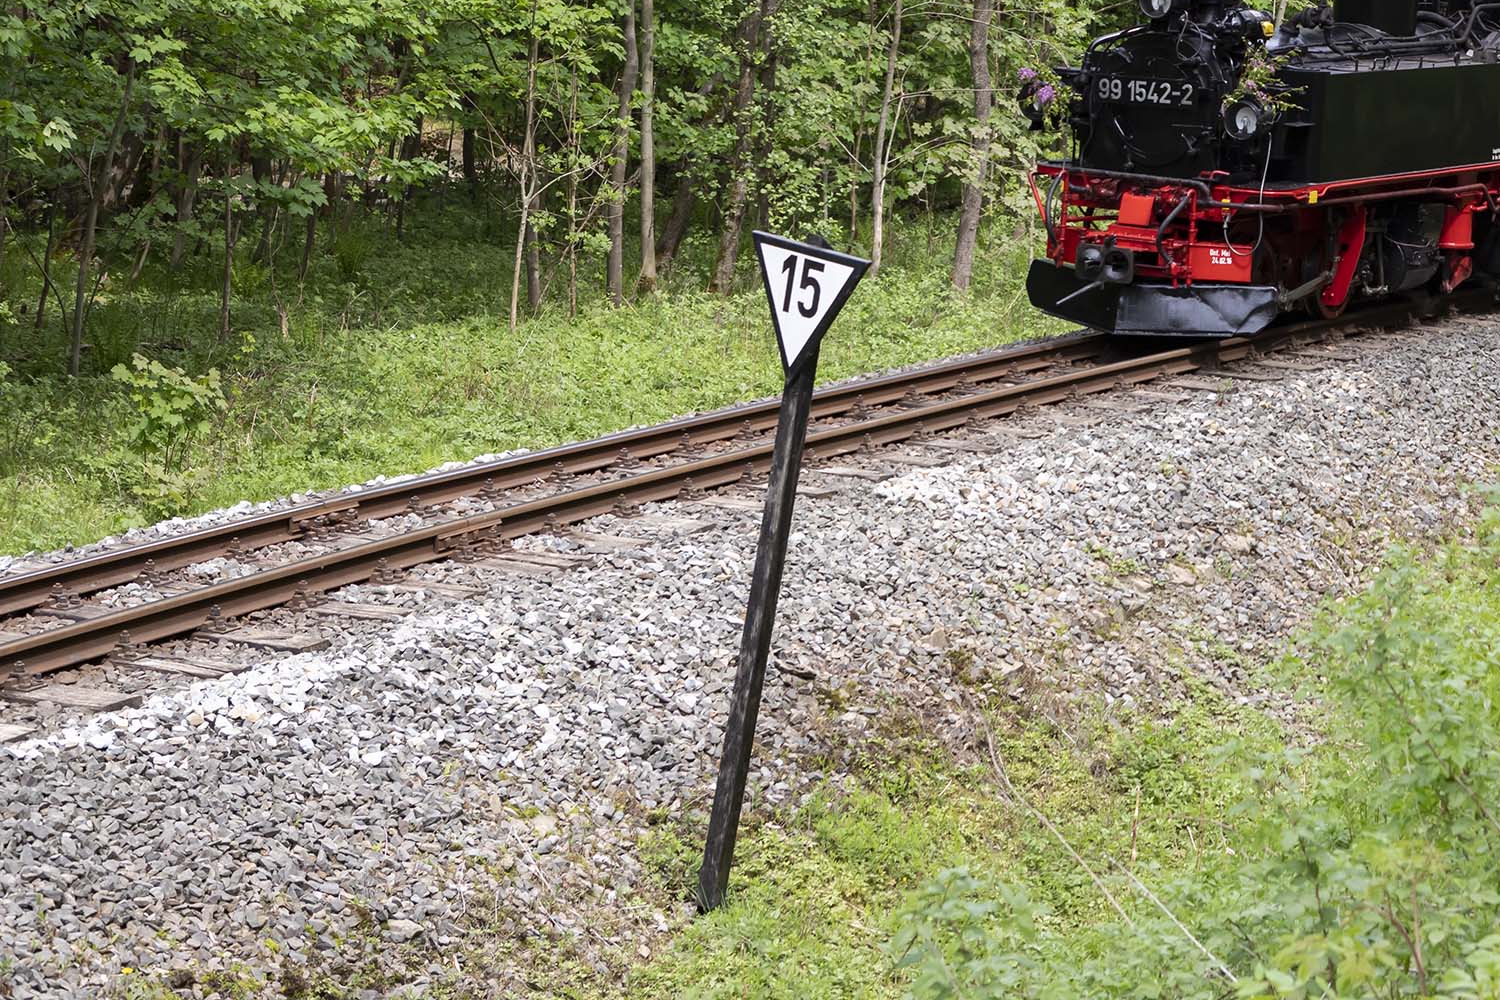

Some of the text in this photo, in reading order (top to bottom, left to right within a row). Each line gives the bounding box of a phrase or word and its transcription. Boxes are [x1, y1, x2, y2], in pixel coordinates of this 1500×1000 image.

[1099, 78, 1193, 105] 99 1542-2
[781, 254, 825, 319] 15
